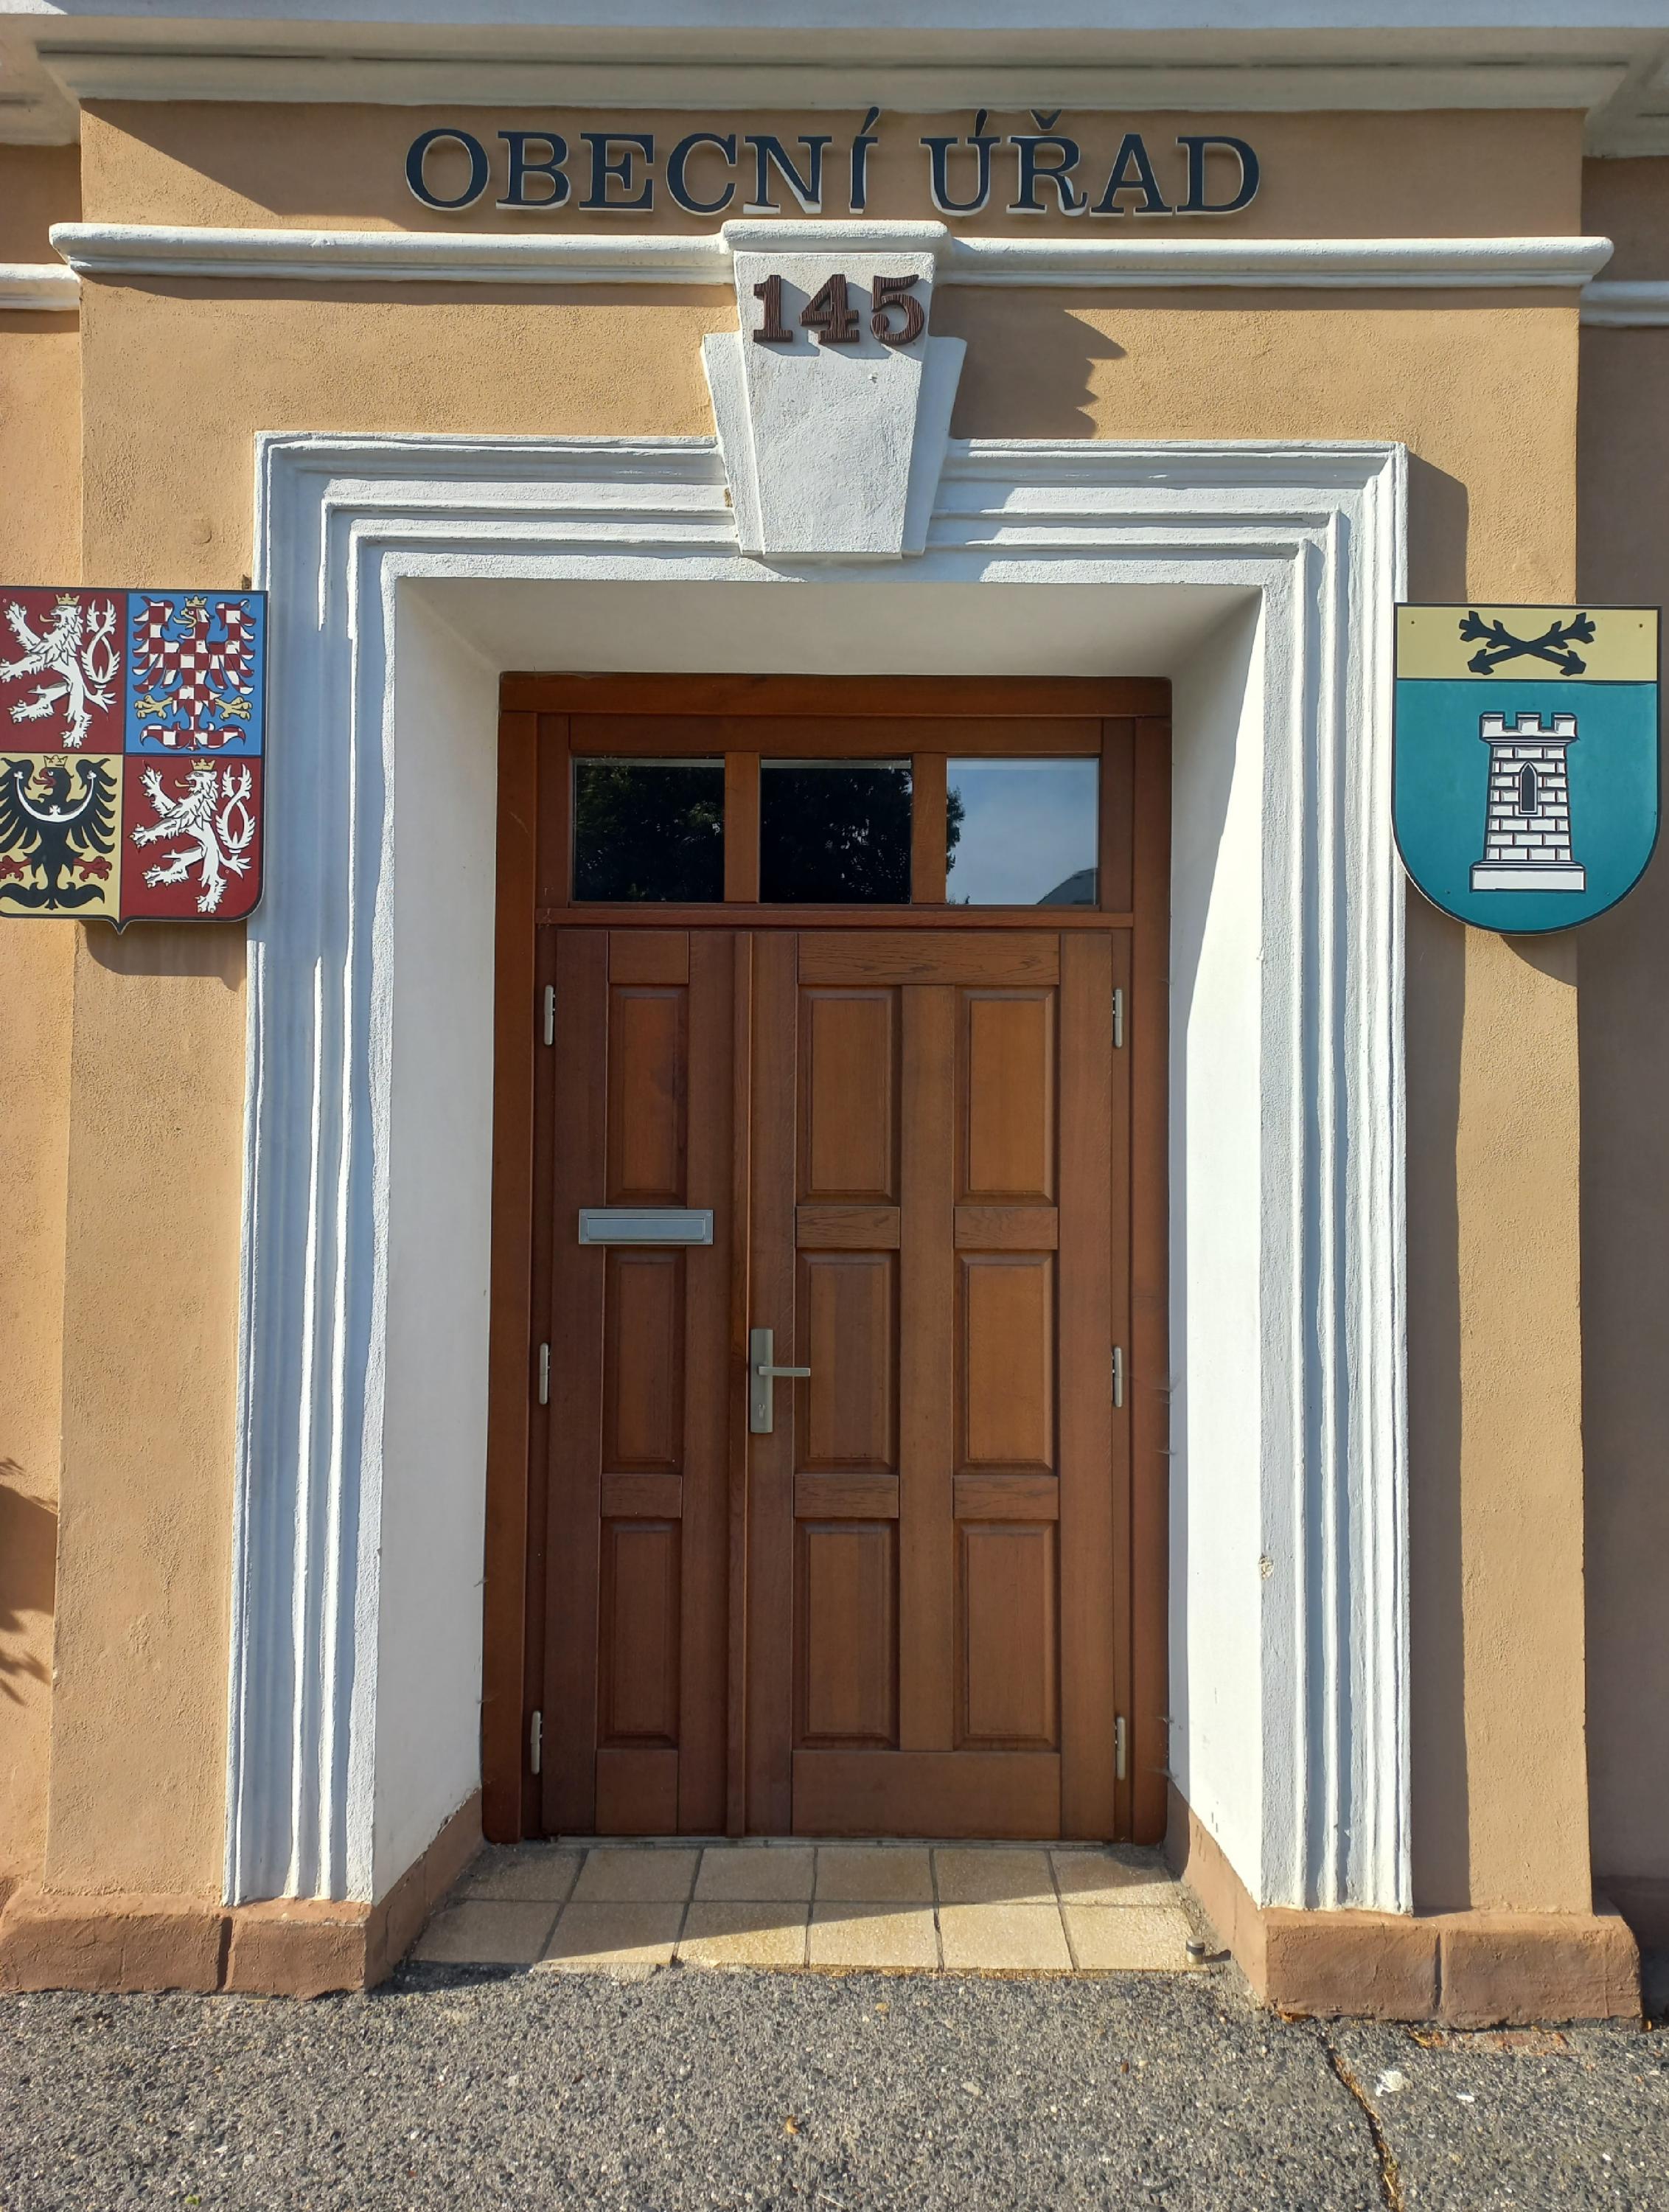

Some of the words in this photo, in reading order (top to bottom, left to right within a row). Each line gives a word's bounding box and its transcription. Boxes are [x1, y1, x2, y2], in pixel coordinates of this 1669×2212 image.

[405, 106, 879, 215] OBECNÍ
[919, 108, 1261, 217] ÚŘAD
[753, 274, 925, 346] 145
